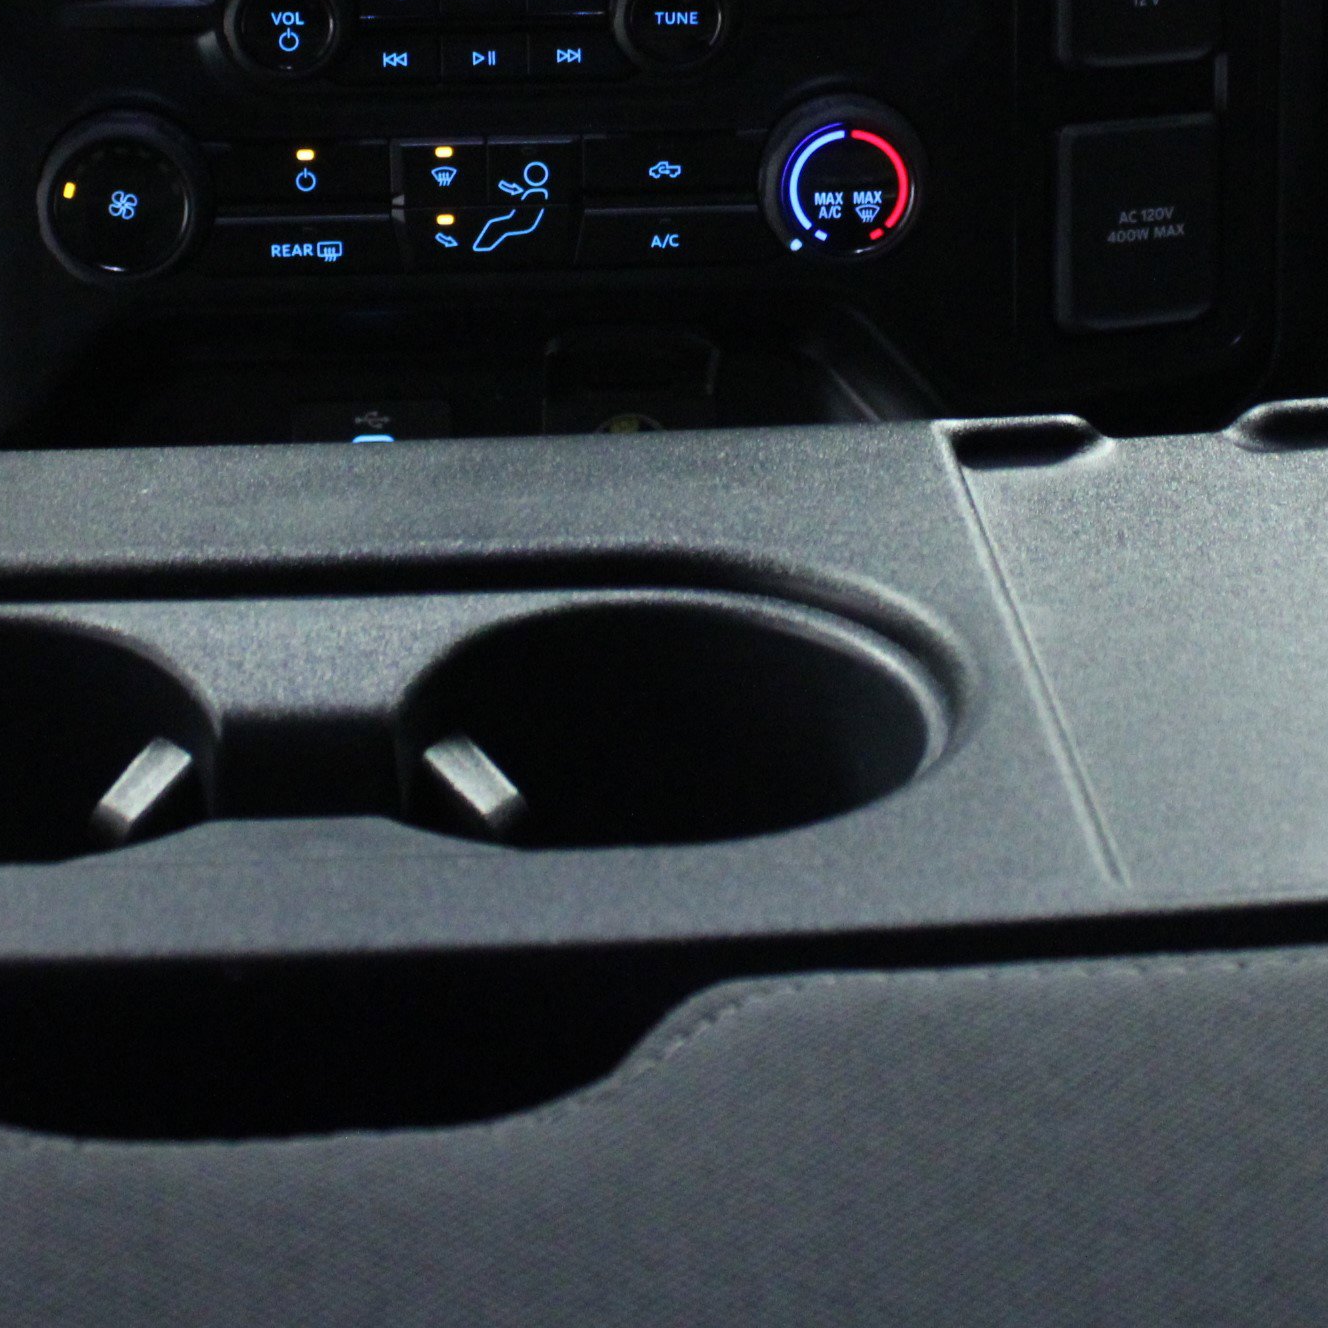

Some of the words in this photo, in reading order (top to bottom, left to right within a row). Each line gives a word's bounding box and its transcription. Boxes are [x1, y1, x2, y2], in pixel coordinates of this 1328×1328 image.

[271, 11, 304, 25] VOL
[655, 11, 698, 25] TUNE
[815, 192, 843, 205] MAX
[853, 190, 882, 204] MAX
[819, 205, 842, 219] A/C
[1119, 209, 1138, 224] AC
[1141, 206, 1174, 222] 120V
[1108, 227, 1150, 243] 400W
[1154, 223, 1186, 239] MAX
[651, 234, 680, 248] A/C
[271, 243, 314, 257] REAR
